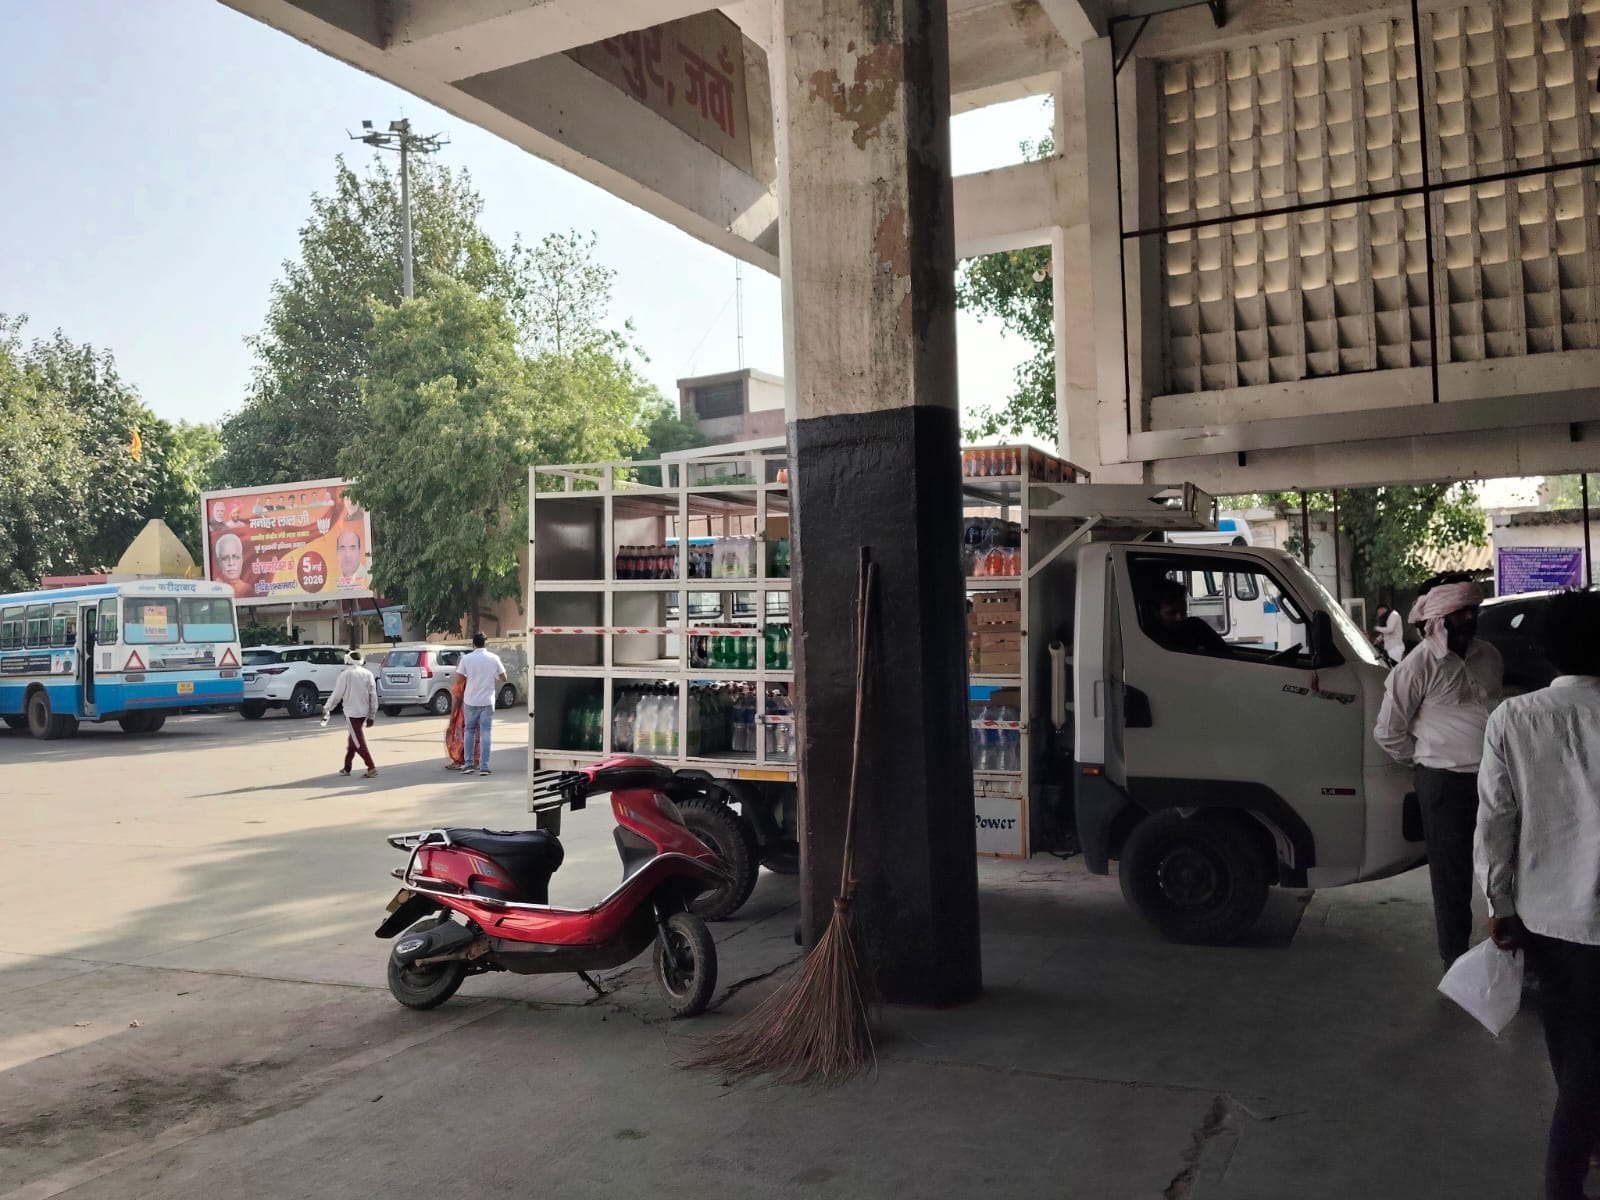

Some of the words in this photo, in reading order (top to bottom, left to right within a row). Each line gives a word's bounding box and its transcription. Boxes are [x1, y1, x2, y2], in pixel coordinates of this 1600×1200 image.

[278, 516, 296, 527] लाल
[303, 557, 312, 573] 5
[303, 575, 324, 585] 2026
[158, 581, 197, 593] फरीदाबाद
